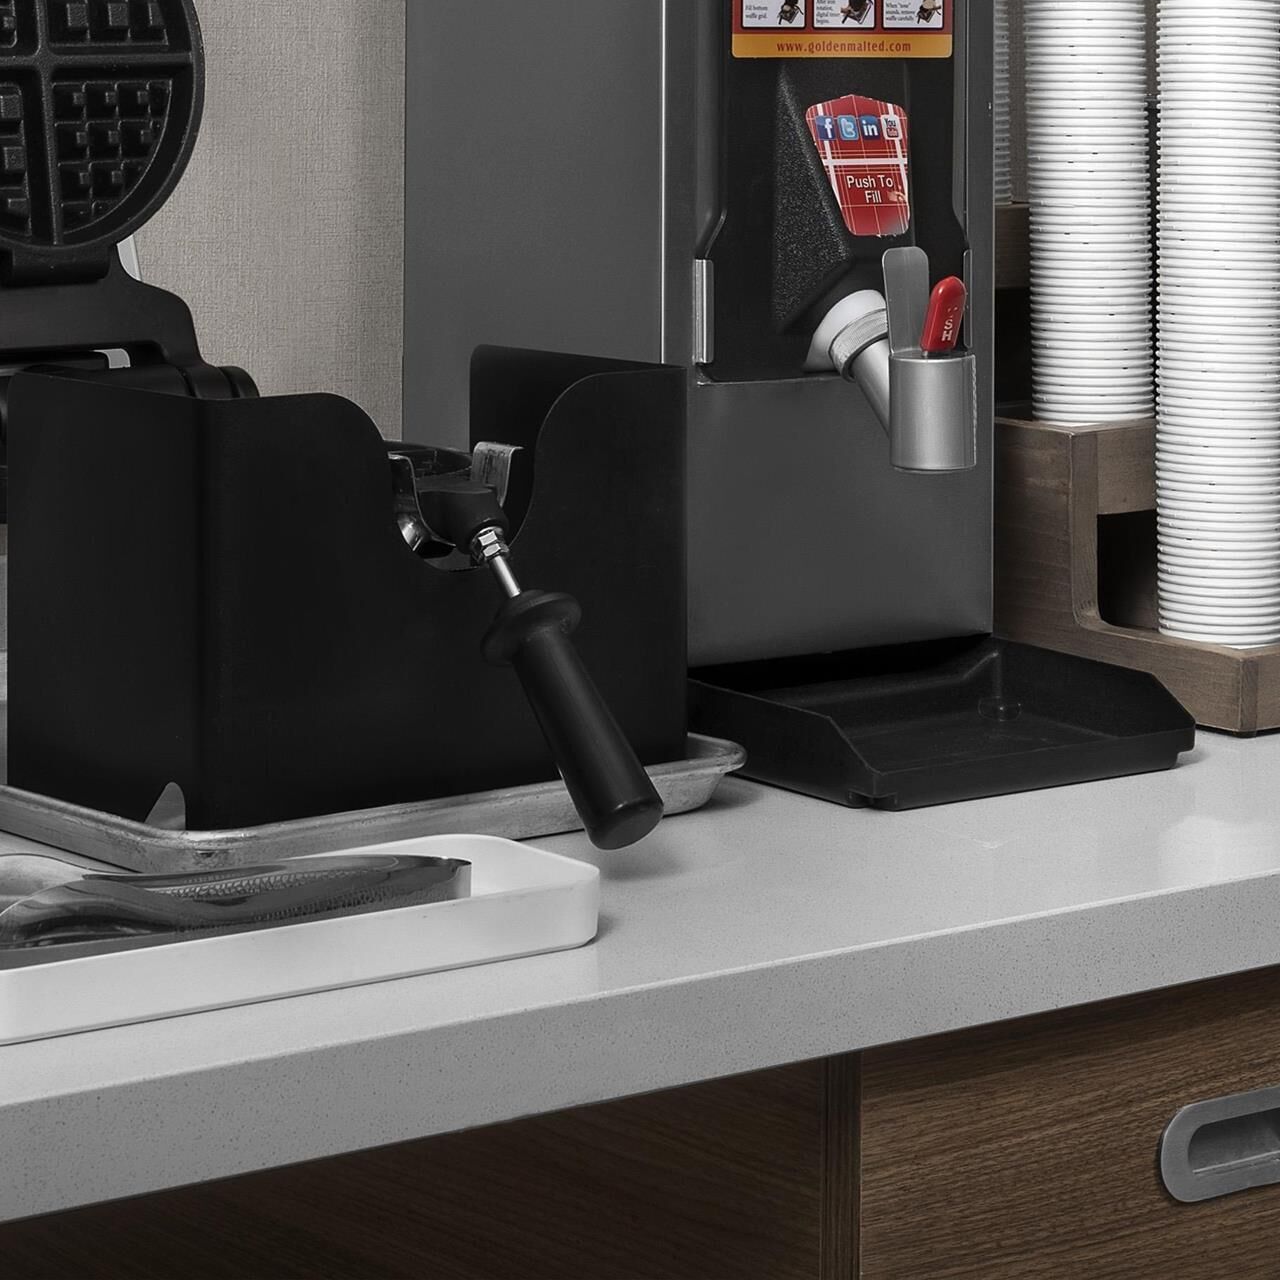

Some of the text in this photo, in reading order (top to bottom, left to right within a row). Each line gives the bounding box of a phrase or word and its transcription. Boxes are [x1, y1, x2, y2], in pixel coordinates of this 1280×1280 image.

[776, 41, 912, 53] www.goldenmalted.com
[846, 175, 894, 189] Push To
[865, 190, 882, 204] Fill
